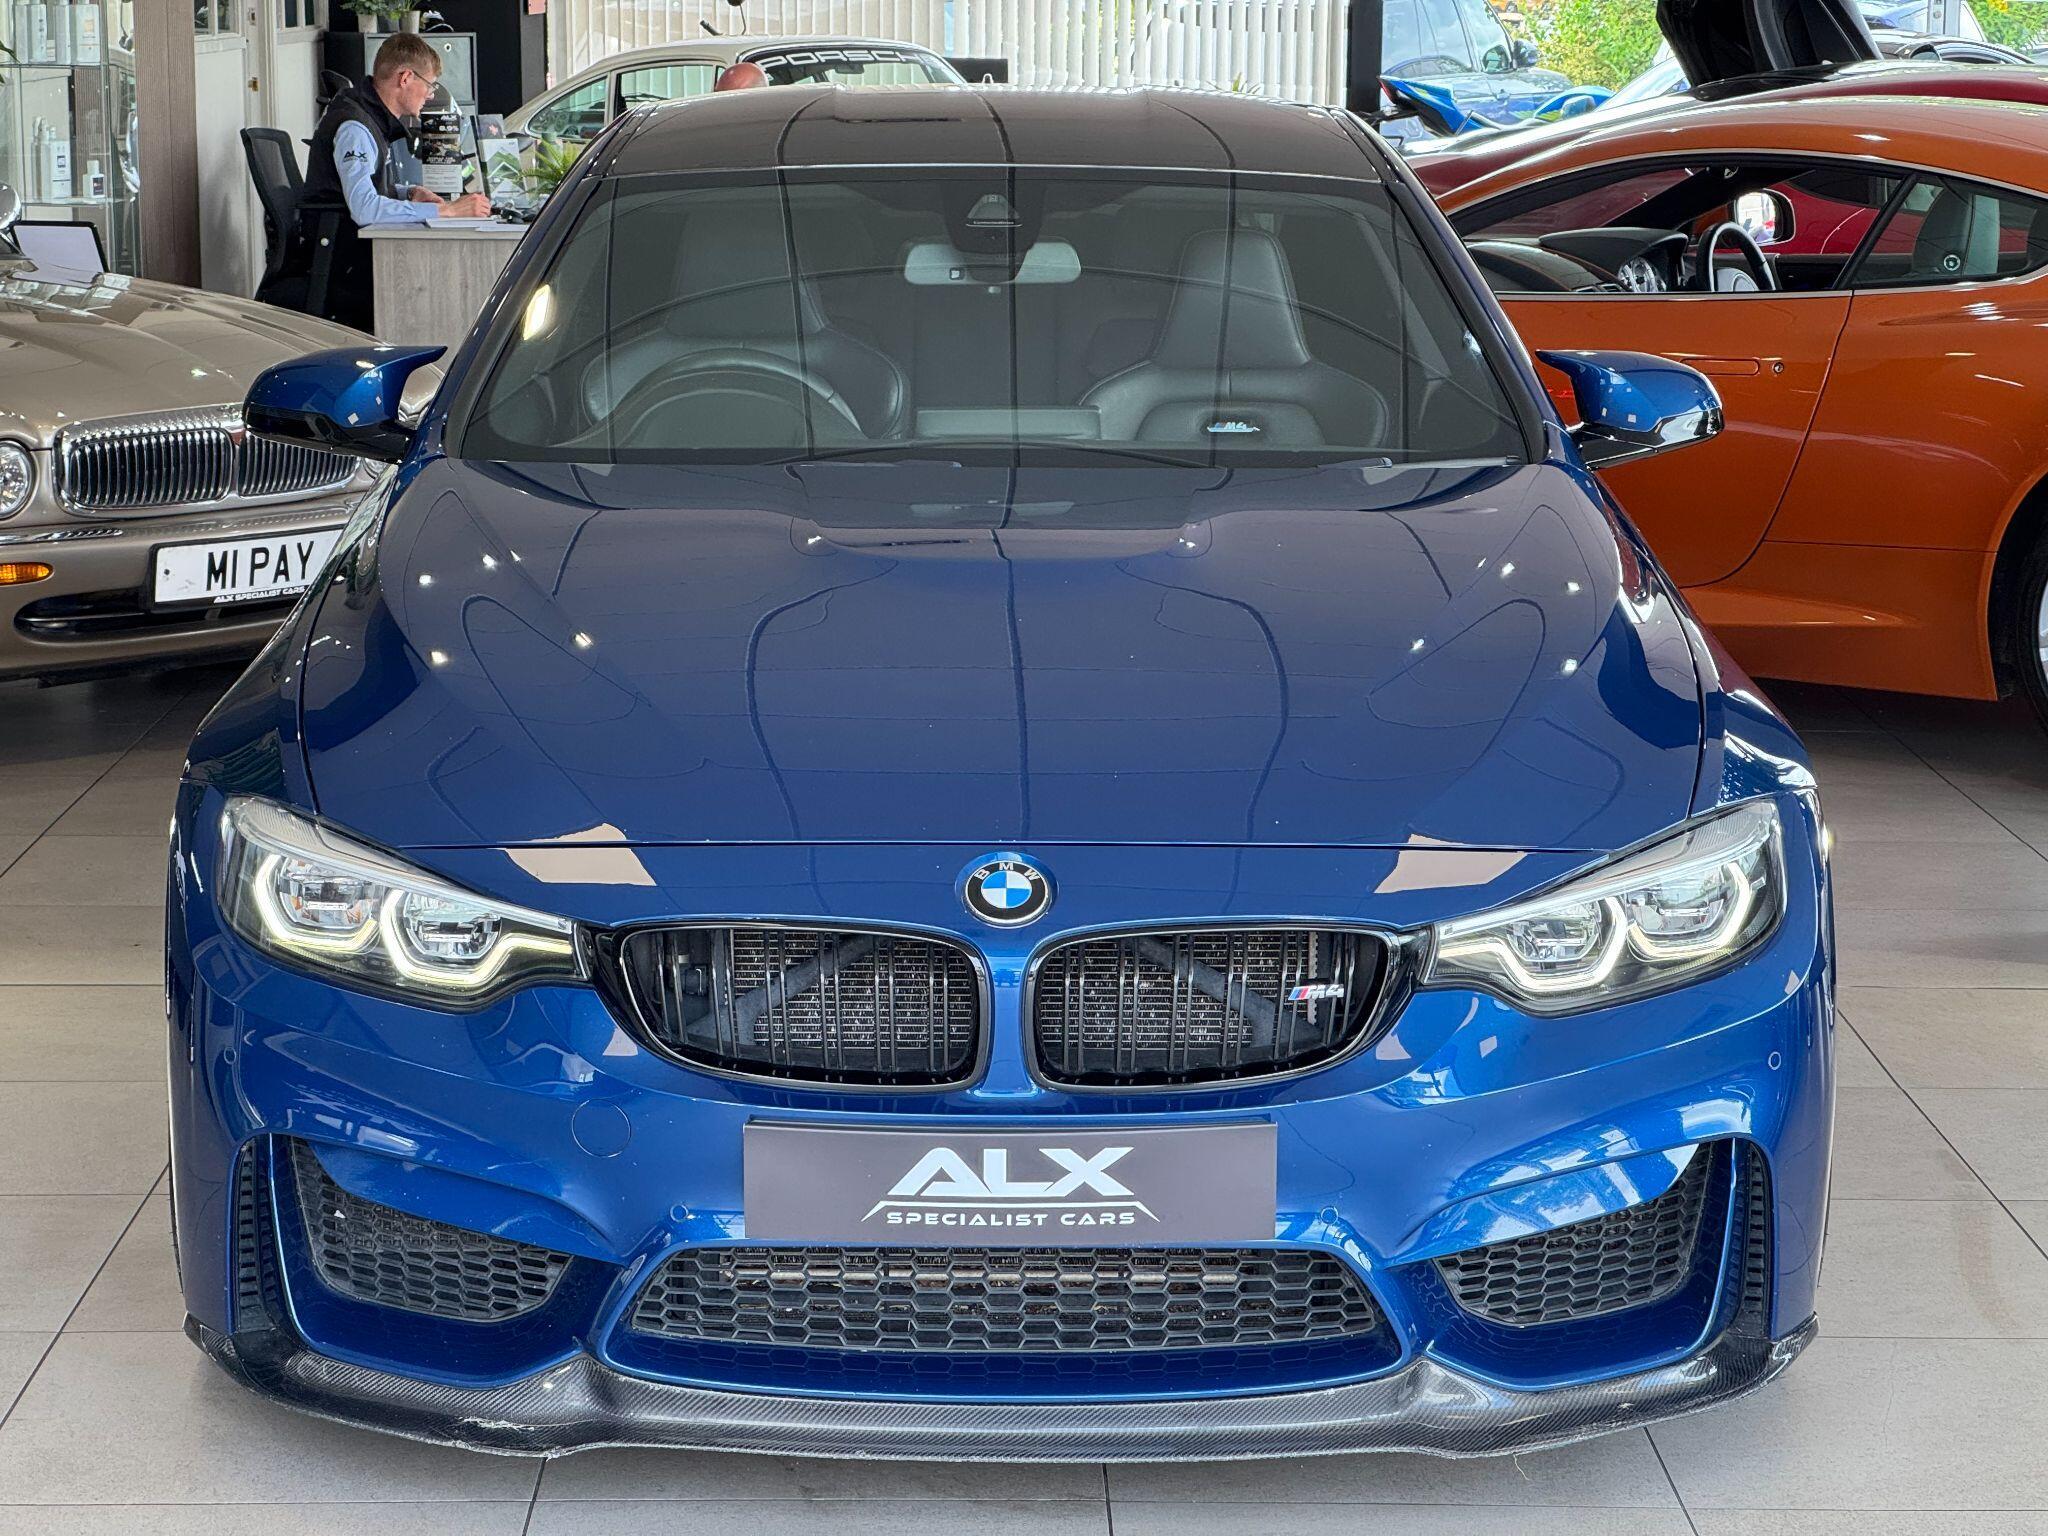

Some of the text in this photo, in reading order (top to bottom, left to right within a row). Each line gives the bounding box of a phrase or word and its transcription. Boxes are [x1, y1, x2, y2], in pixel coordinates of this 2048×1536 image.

[344, 150, 367, 159] ALX
[249, 541, 314, 586] PAY
[213, 586, 305, 603] ALX SPECIALIST CARS
[974, 862, 1040, 881] BMW
[1306, 984, 1344, 999] M4
[887, 1147, 1135, 1197] ALX
[886, 1211, 1136, 1227] SPECIALIST CARS
